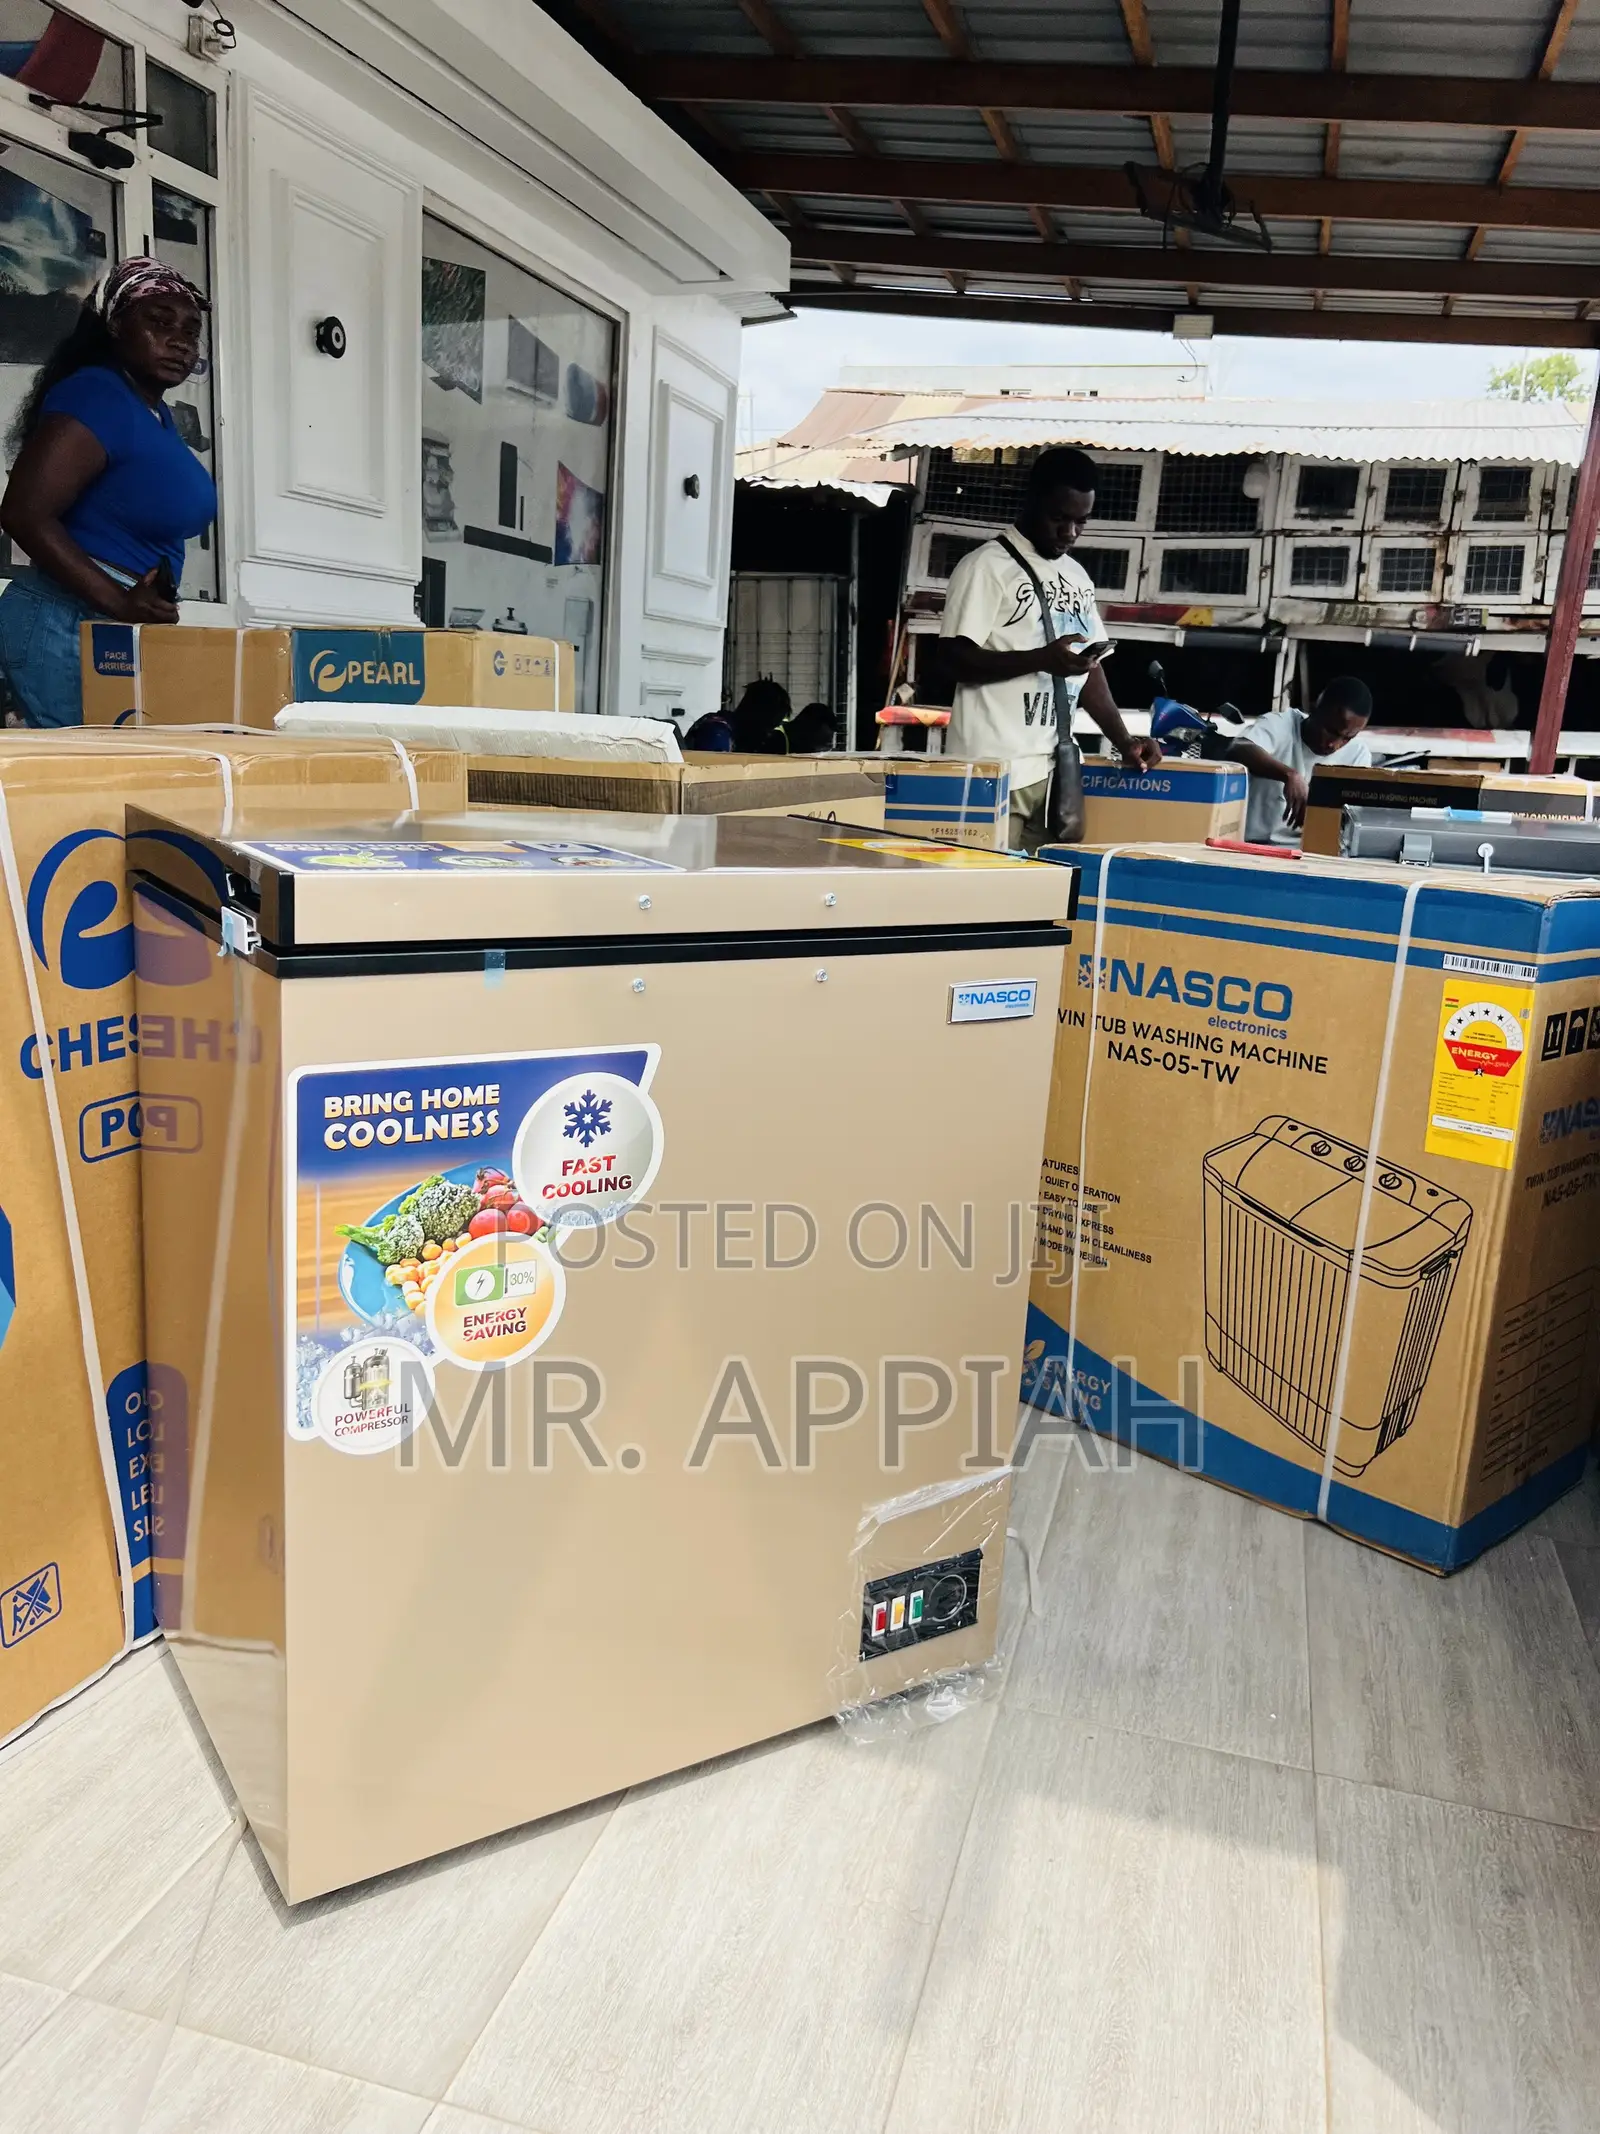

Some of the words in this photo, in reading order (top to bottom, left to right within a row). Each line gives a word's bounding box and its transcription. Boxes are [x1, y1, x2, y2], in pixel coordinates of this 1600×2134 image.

[105, 651, 127, 660] FACE
[347, 660, 421, 685] PEARL
[970, 989, 1031, 1005] NASCO
[1109, 959, 1293, 1021] NASCO
[1207, 1015, 1288, 1040] electronics
[1132, 1021, 1224, 1054] WASHING
[1230, 1042, 1328, 1075] MACHINE
[1451, 1046, 1499, 1061] ENERGY
[1107, 1041, 1241, 1085] NAS-05-TW
[324, 1092, 414, 1120] BRING
[421, 1083, 500, 1111] HOME
[323, 1109, 500, 1151] COOLNESS
[562, 1155, 617, 1177] FAST
[542, 1175, 633, 1201] COOLING
[1044, 1191, 1066, 1204] EASY
[1068, 1198, 1079, 1208] TO
[1045, 1176, 1070, 1190] QUIET
[1072, 1183, 1121, 1204] OERATION
[1042, 1207, 1073, 1223] DRYING
[1076, 1215, 1114, 1235] XPRESS
[1039, 1237, 1075, 1256] MODERN
[1041, 1222, 1064, 1236] HAND
[1092, 1238, 1152, 1264] CLEANLINESS
[509, 1272, 534, 1286] 30%
[463, 1306, 528, 1328] ENERGY
[463, 1320, 527, 1342] SAVING
[1044, 1359, 1111, 1394] ENRGY
[334, 1402, 412, 1427] POWERFUL
[334, 1415, 409, 1438] COMPRESSOR
